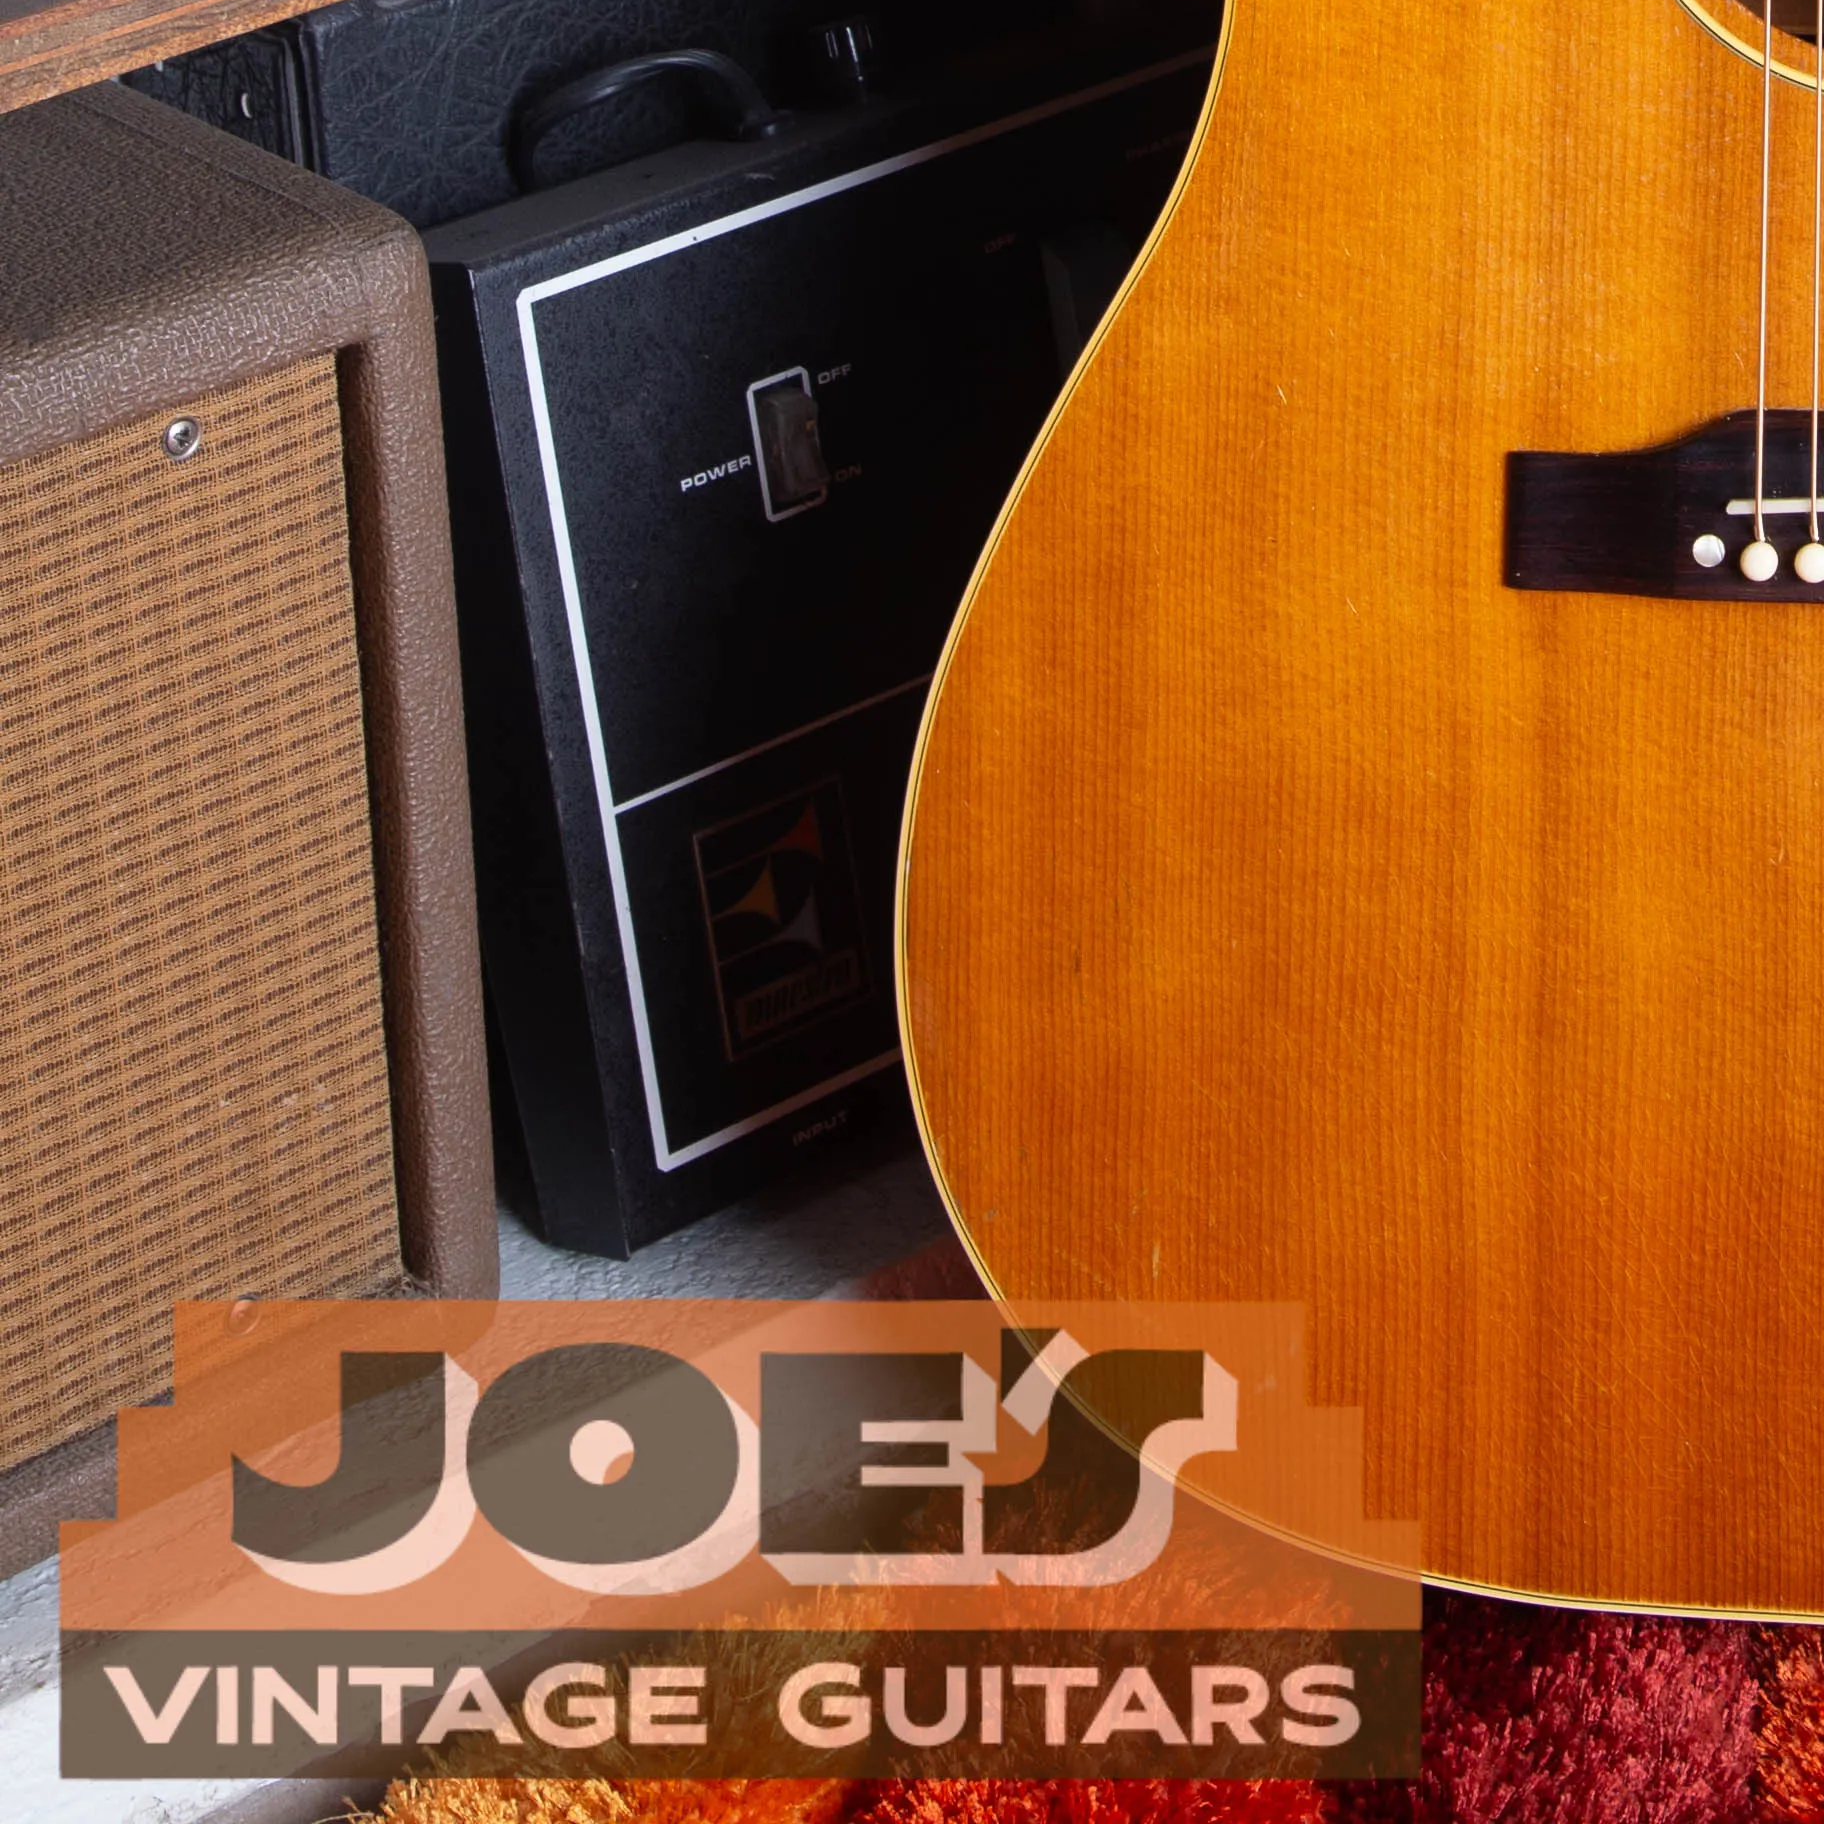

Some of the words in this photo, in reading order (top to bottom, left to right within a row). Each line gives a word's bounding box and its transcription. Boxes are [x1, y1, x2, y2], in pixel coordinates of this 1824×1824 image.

[816, 362, 853, 386] OFF
[679, 453, 753, 494] POWER
[833, 462, 863, 484] ON
[791, 1108, 851, 1148] INPUT
